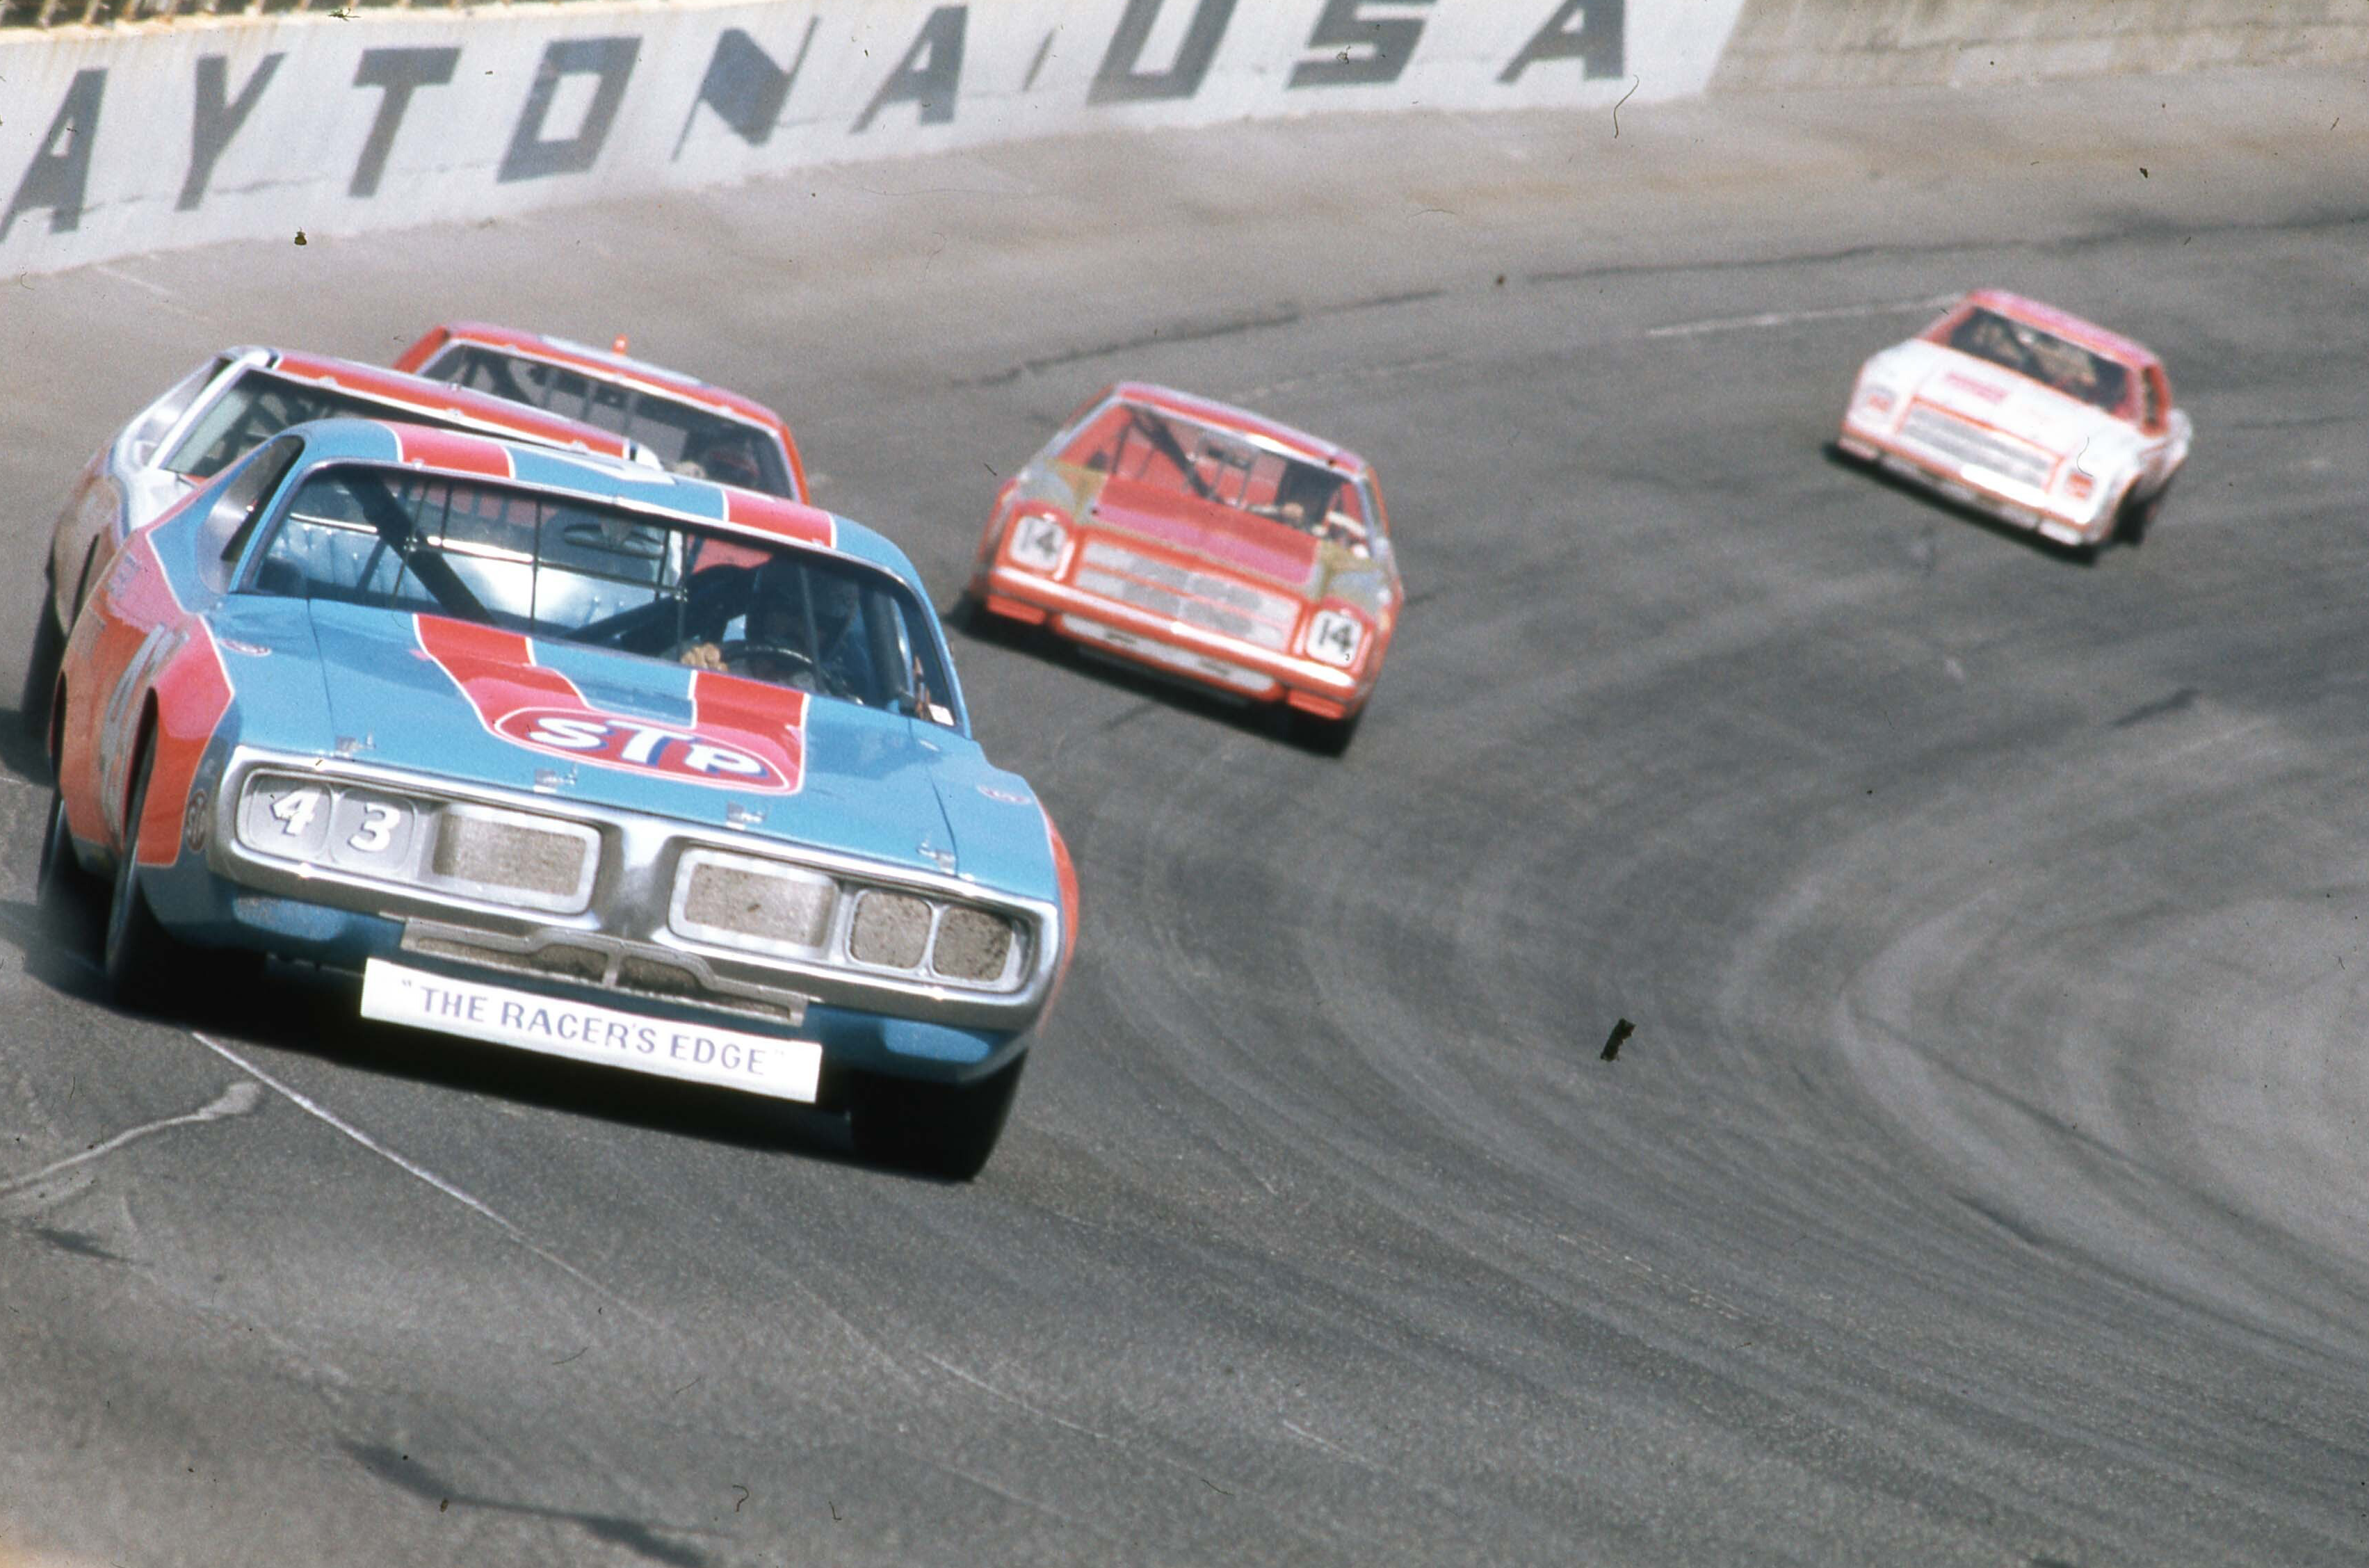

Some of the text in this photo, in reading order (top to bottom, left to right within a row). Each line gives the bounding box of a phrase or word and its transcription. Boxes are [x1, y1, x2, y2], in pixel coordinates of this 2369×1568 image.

[0, 0, 1626, 243] AYTONA USA
[1318, 618, 1352, 652] 14
[527, 718, 768, 776] STP
